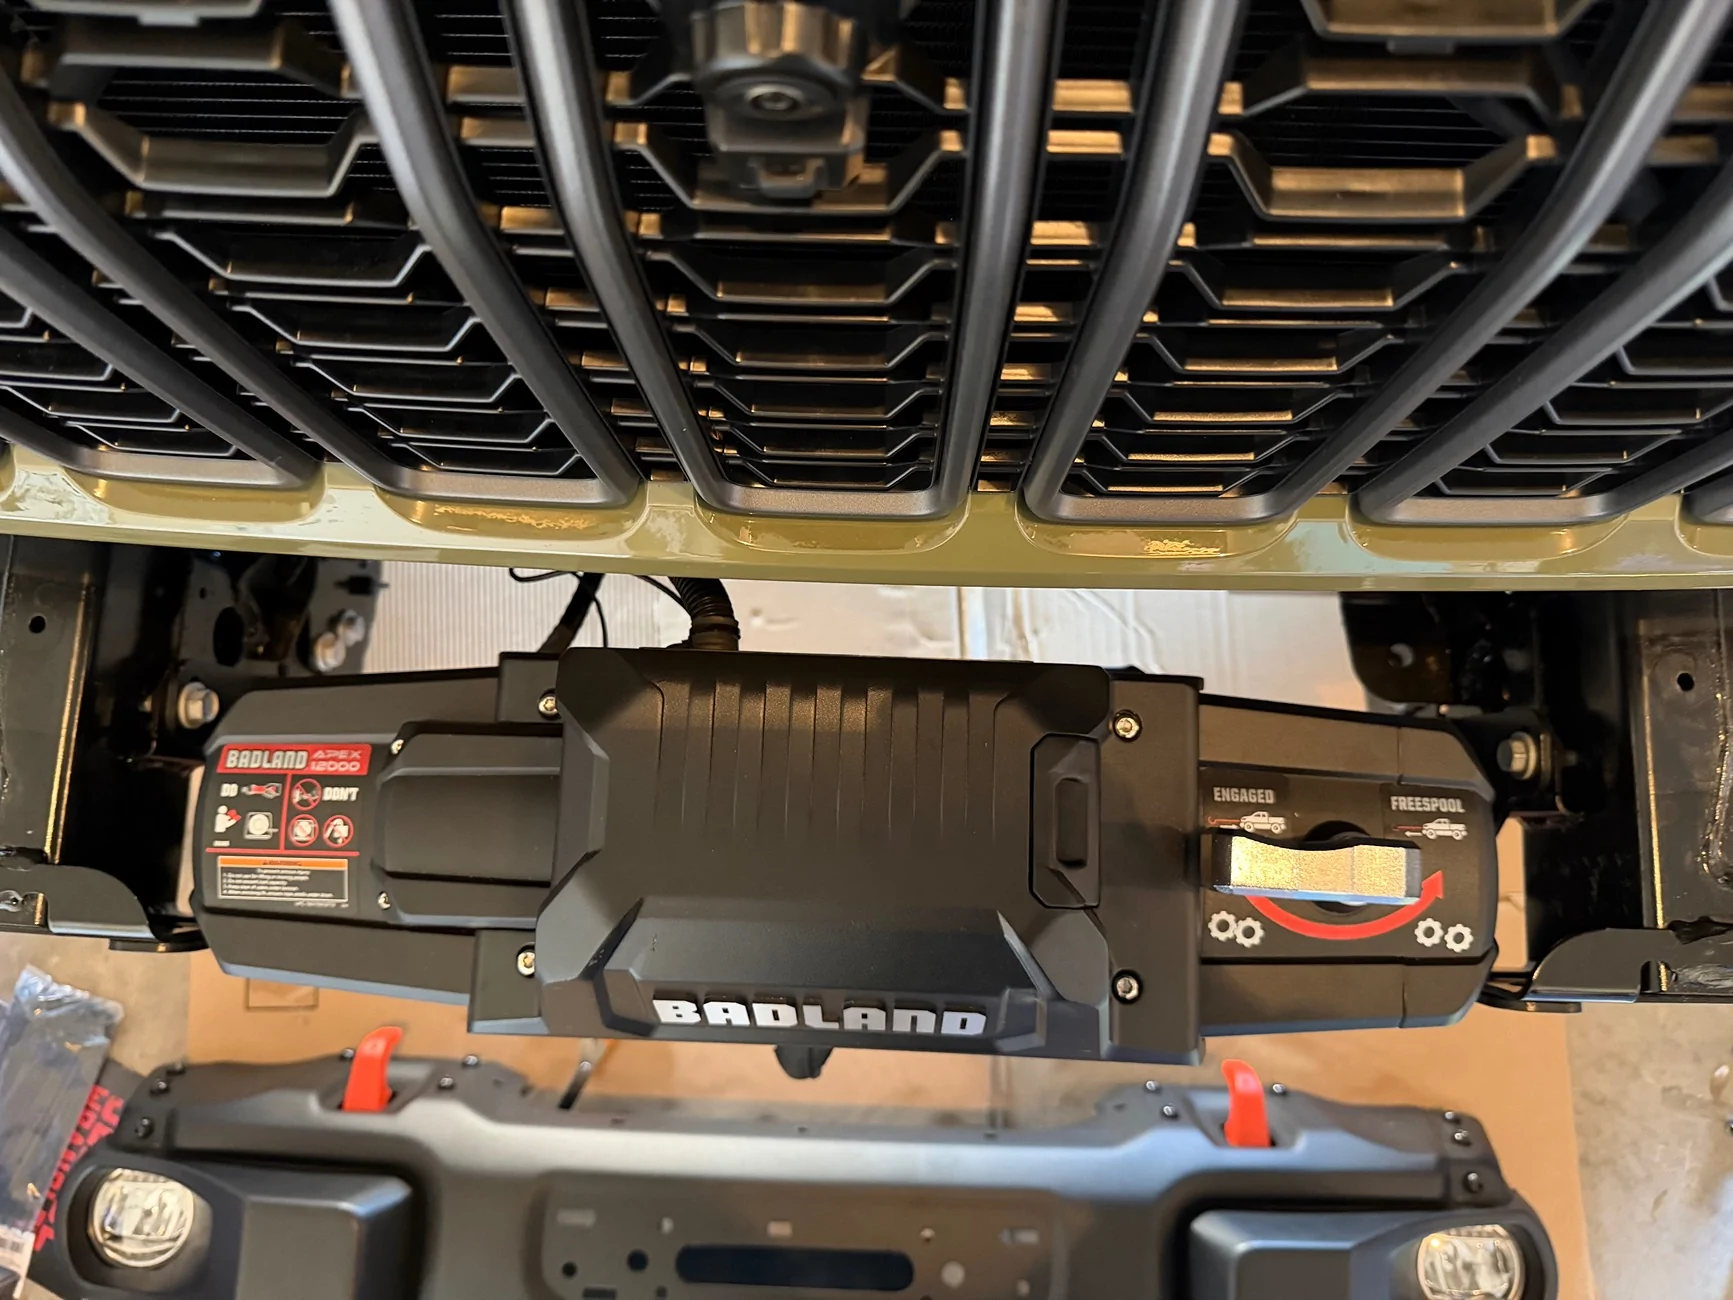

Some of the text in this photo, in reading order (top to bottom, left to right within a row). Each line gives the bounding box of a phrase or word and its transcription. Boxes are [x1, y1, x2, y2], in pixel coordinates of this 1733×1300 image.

[225, 749, 308, 770] BADLAND
[311, 749, 361, 759] APEX
[310, 761, 360, 771] 12000
[220, 783, 239, 797] DO
[322, 787, 359, 801] DON'T
[1213, 786, 1276, 804] ENGAGED
[1391, 796, 1466, 813] FREESPOOL
[653, 998, 987, 1036] BADLAND
